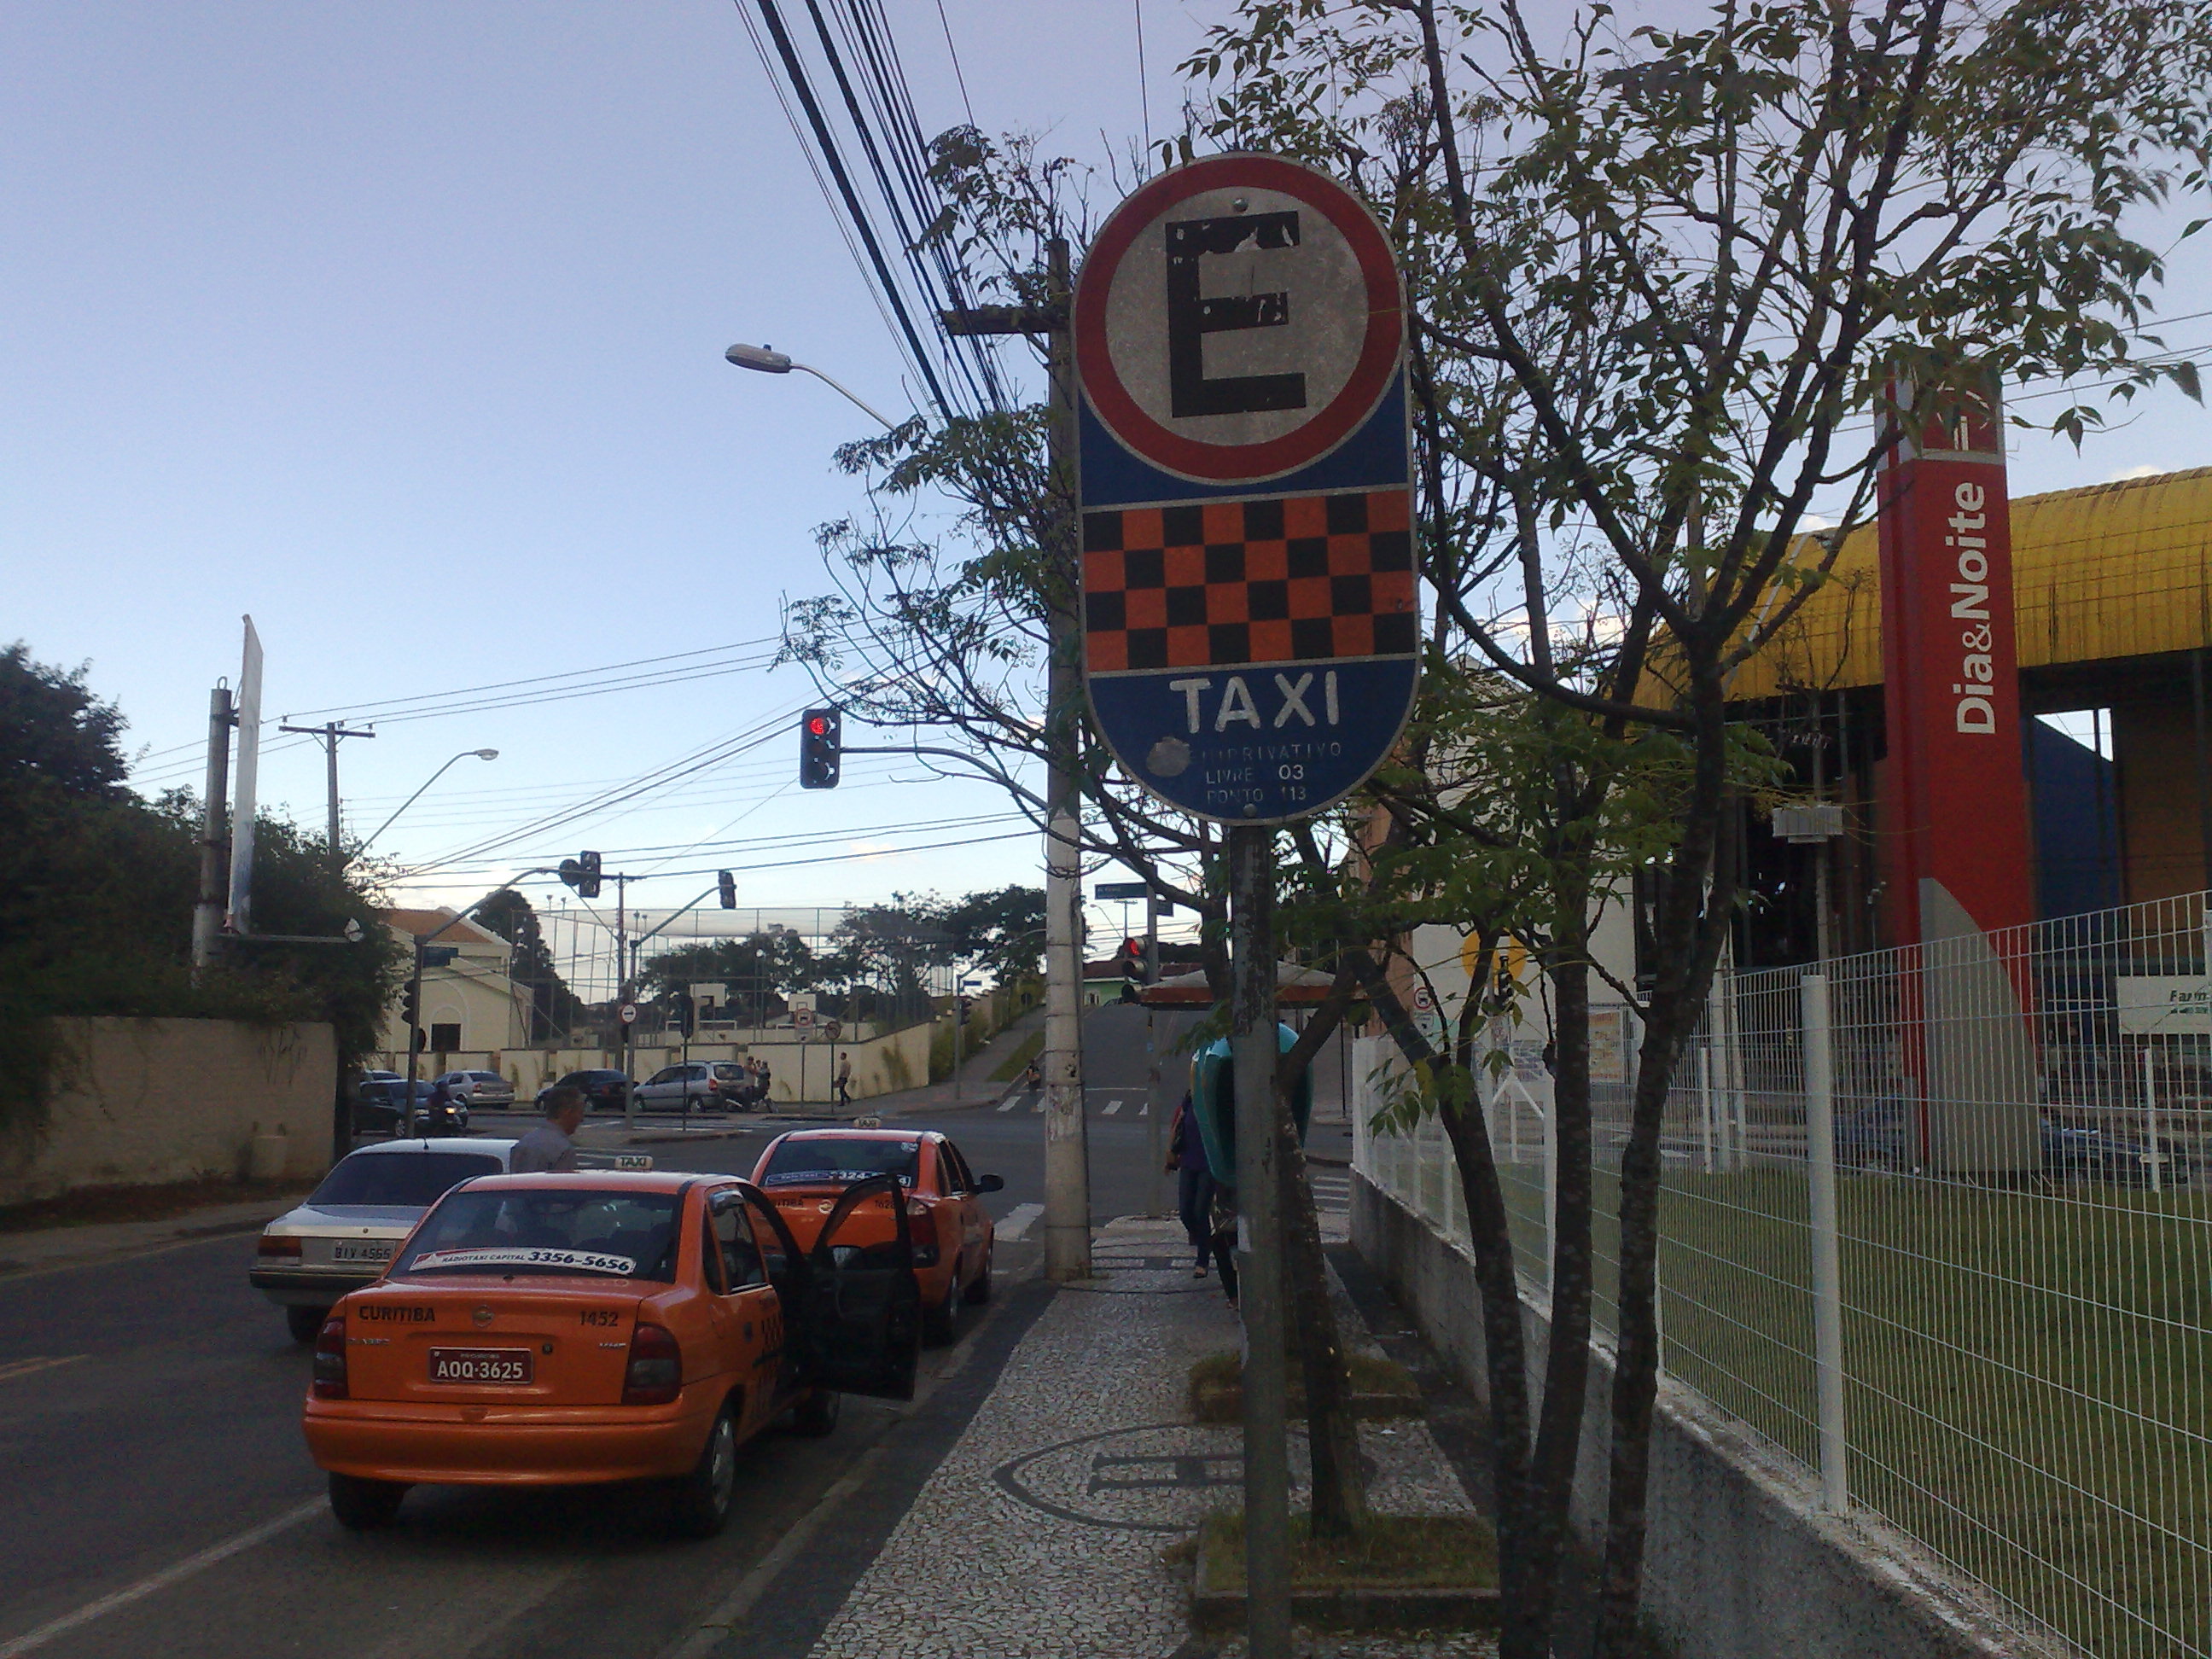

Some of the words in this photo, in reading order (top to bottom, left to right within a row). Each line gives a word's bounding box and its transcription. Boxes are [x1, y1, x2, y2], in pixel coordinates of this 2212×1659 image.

[1166, 211, 1307, 418] E
[1945, 481, 1996, 736] Dia&Noite
[1169, 670, 1341, 733] TAXI
[1206, 767, 1254, 784] LIVRE
[1278, 764, 1305, 780] 03
[621, 1156, 646, 1167] TAXI
[527, 1251, 630, 1272] 3356-5656
[358, 1305, 435, 1322] CURITIBA
[580, 1310, 619, 1327] 1452
